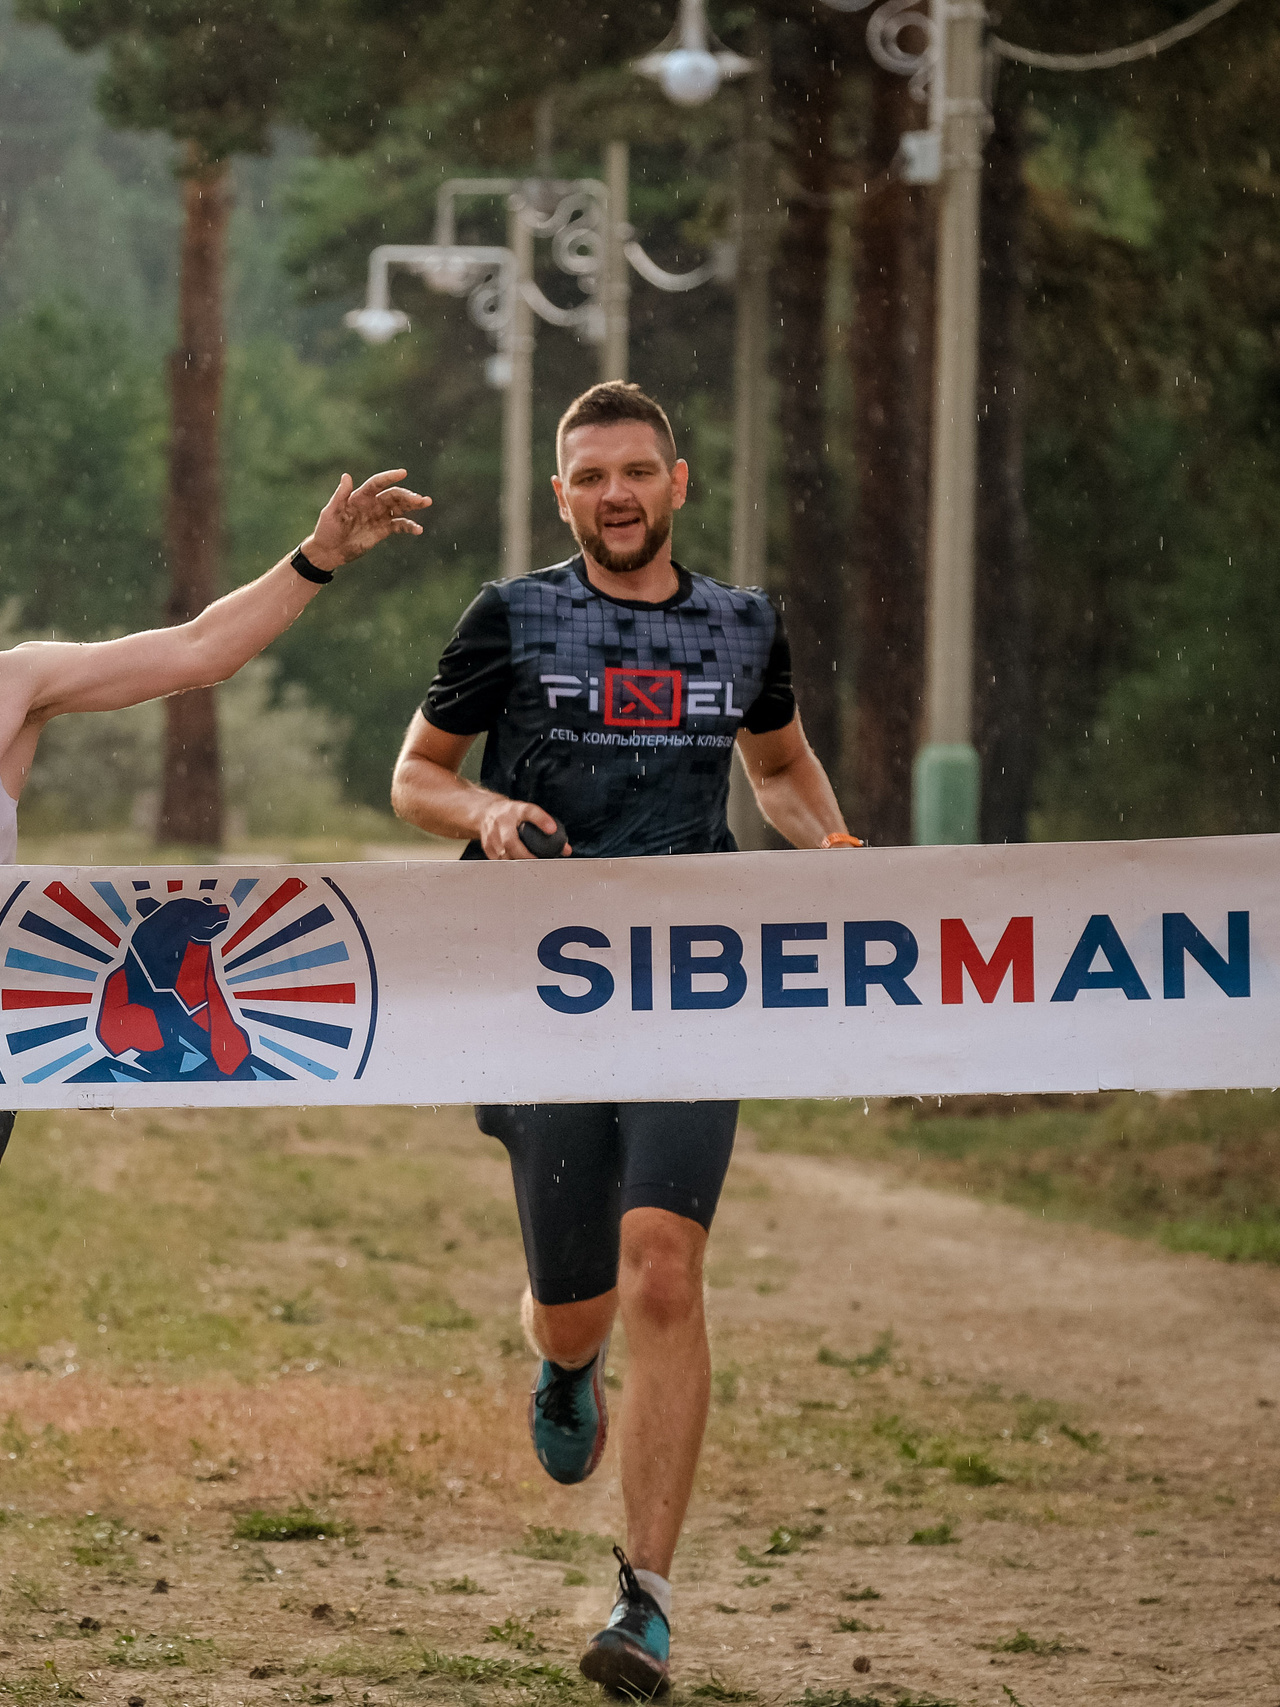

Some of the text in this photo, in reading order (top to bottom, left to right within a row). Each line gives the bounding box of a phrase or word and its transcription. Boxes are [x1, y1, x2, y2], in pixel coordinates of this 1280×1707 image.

[549, 727, 579, 743] СЕТЬ
[582, 732, 694, 747] КОМПЬЮТЕРНЫХ
[536, 910, 1251, 1015] SIBERMAN
